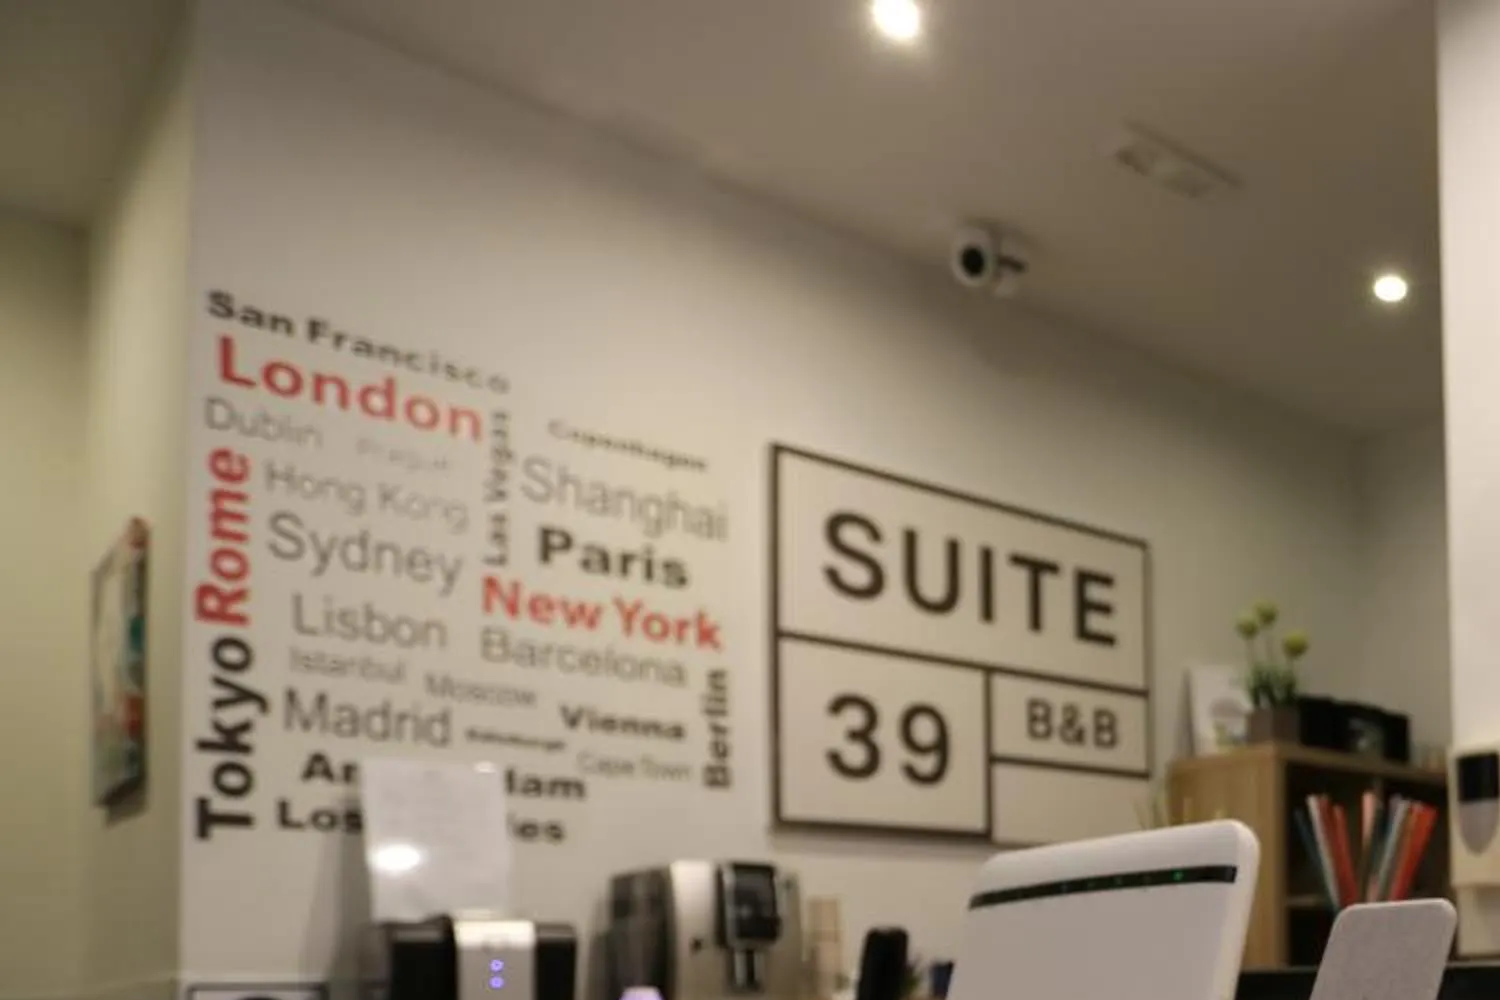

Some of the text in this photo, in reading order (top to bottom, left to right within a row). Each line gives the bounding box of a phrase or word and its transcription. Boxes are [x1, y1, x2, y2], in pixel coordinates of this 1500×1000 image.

[206, 289, 510, 394] San Francisco
[204, 395, 323, 448] Dublin
[217, 334, 484, 443] London
[263, 459, 471, 535] Hong Kong
[518, 454, 729, 543] Shanghai
[266, 508, 464, 597] Sydney
[482, 512, 509, 567] Las
[538, 525, 690, 589] Paris
[481, 575, 725, 654] New York
[823, 512, 1116, 646] SUITE
[193, 446, 270, 841] Tokyo Rome
[292, 591, 448, 649] Lisbon
[480, 626, 688, 688] Barcelona
[282, 686, 452, 748] Madrid
[559, 703, 687, 741] Vienna
[700, 668, 732, 790] Berlin
[825, 691, 951, 786] 39
[1026, 699, 1120, 751] B&B
